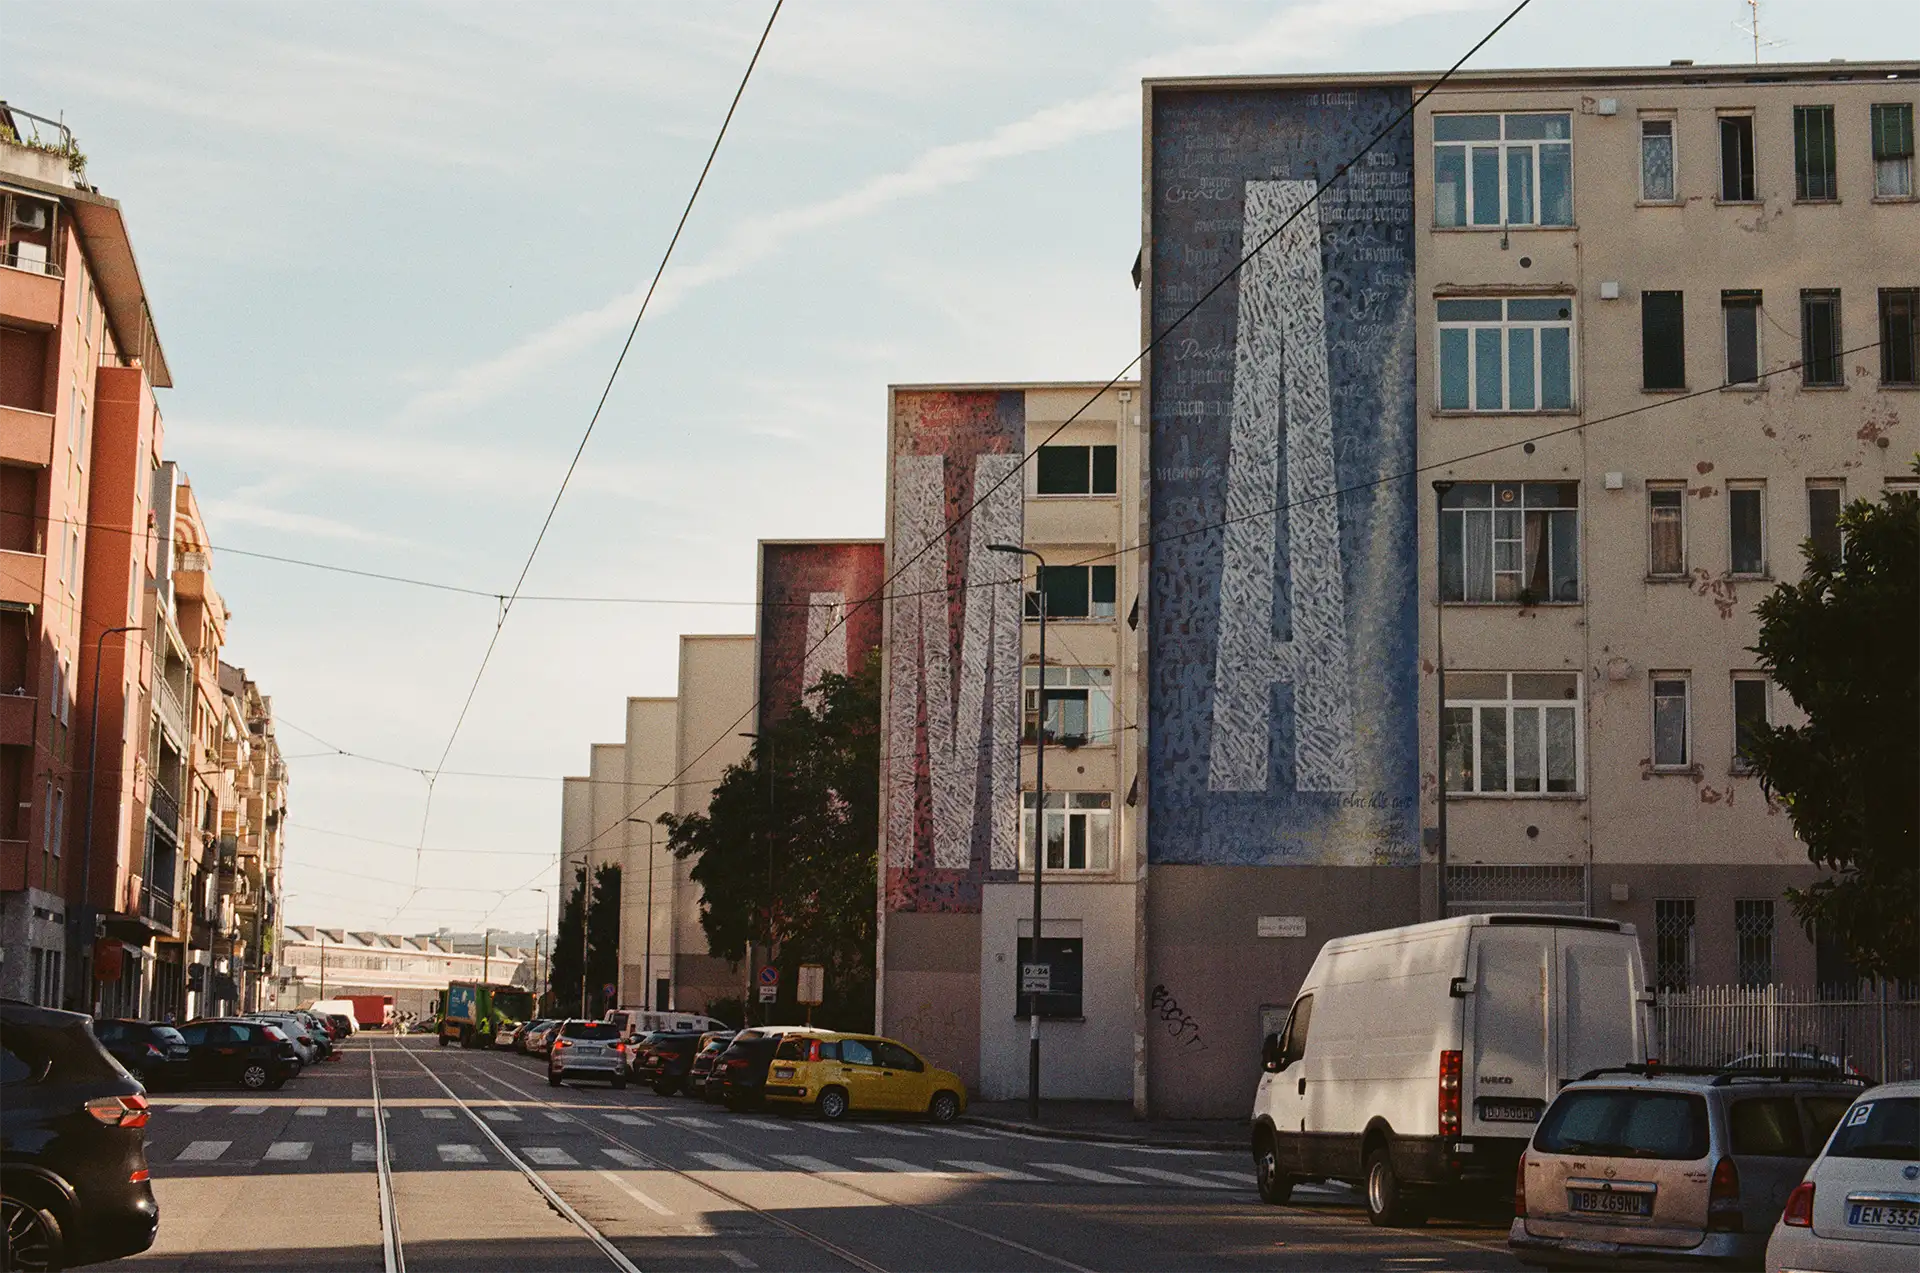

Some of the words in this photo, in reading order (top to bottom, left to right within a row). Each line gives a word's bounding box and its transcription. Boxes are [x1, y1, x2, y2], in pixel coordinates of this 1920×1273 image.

[1480, 1075, 1513, 1085] IVECO
[1851, 1106, 1869, 1124] P
[1862, 1207, 1883, 1223] EN
